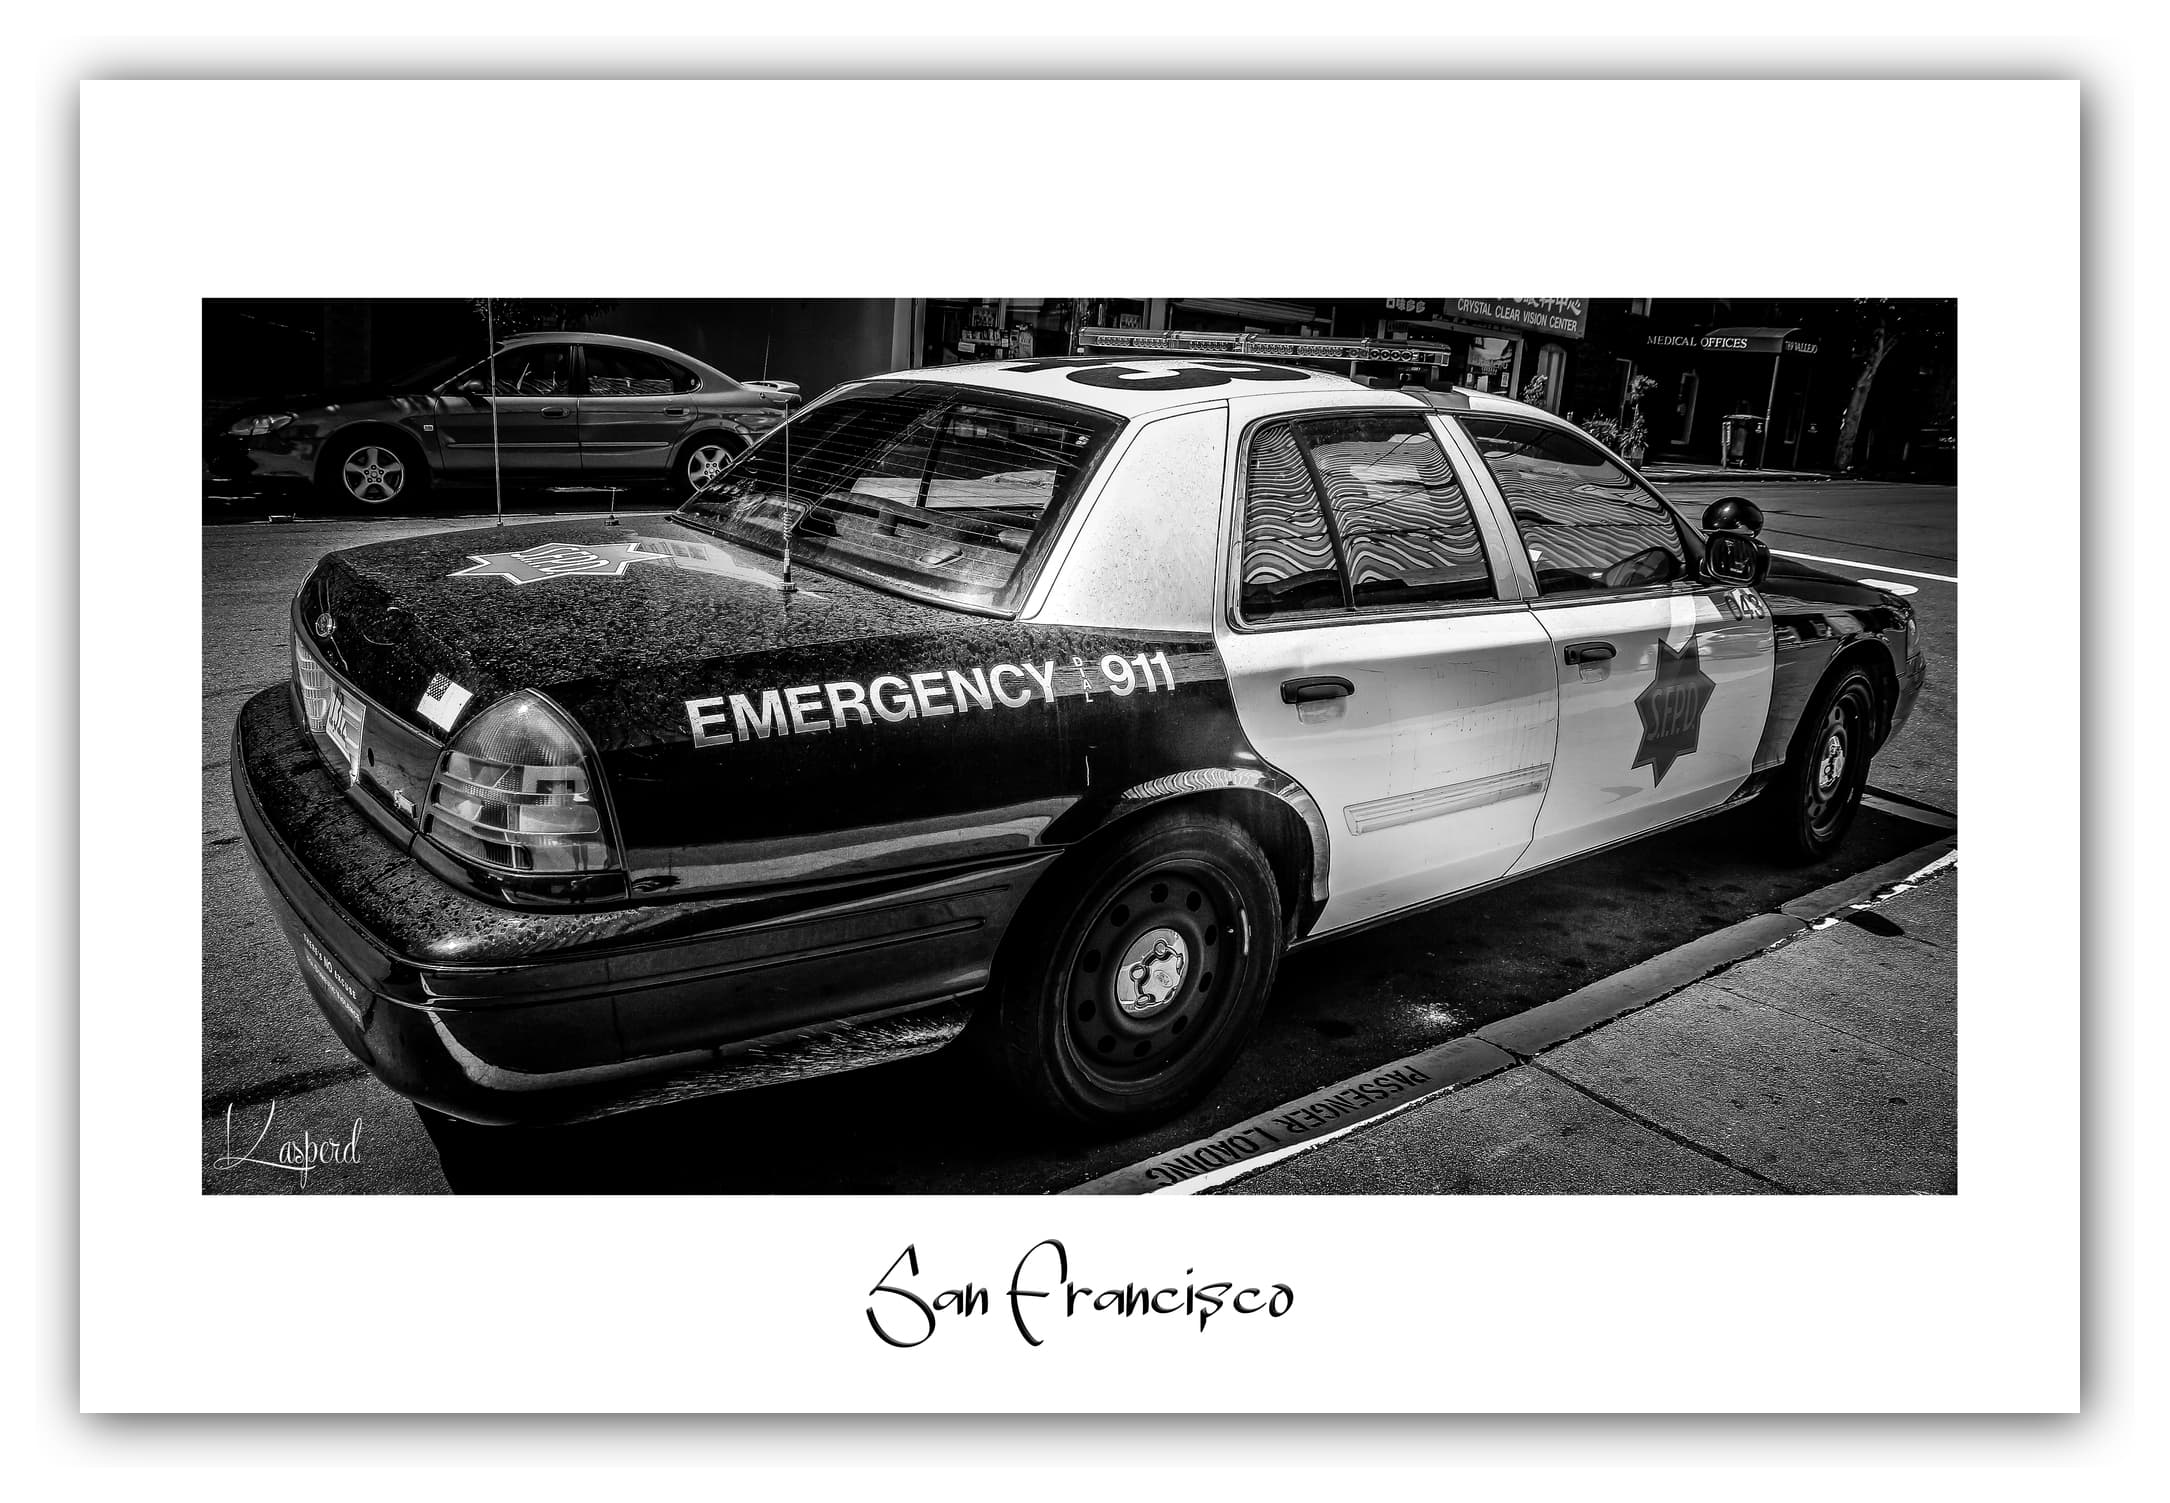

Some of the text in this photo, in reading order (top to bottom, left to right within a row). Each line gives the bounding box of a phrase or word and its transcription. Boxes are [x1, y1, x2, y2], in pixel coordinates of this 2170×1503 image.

[1457, 298, 1577, 332] CRYSTAL CLEAR VISION CENTER
[1647, 336, 1748, 349] MEDICAL OFFICES
[685, 651, 1176, 749] EMERGENCY DIAL 911
[1145, 1065, 1431, 1187] PASSENGER LOADING
